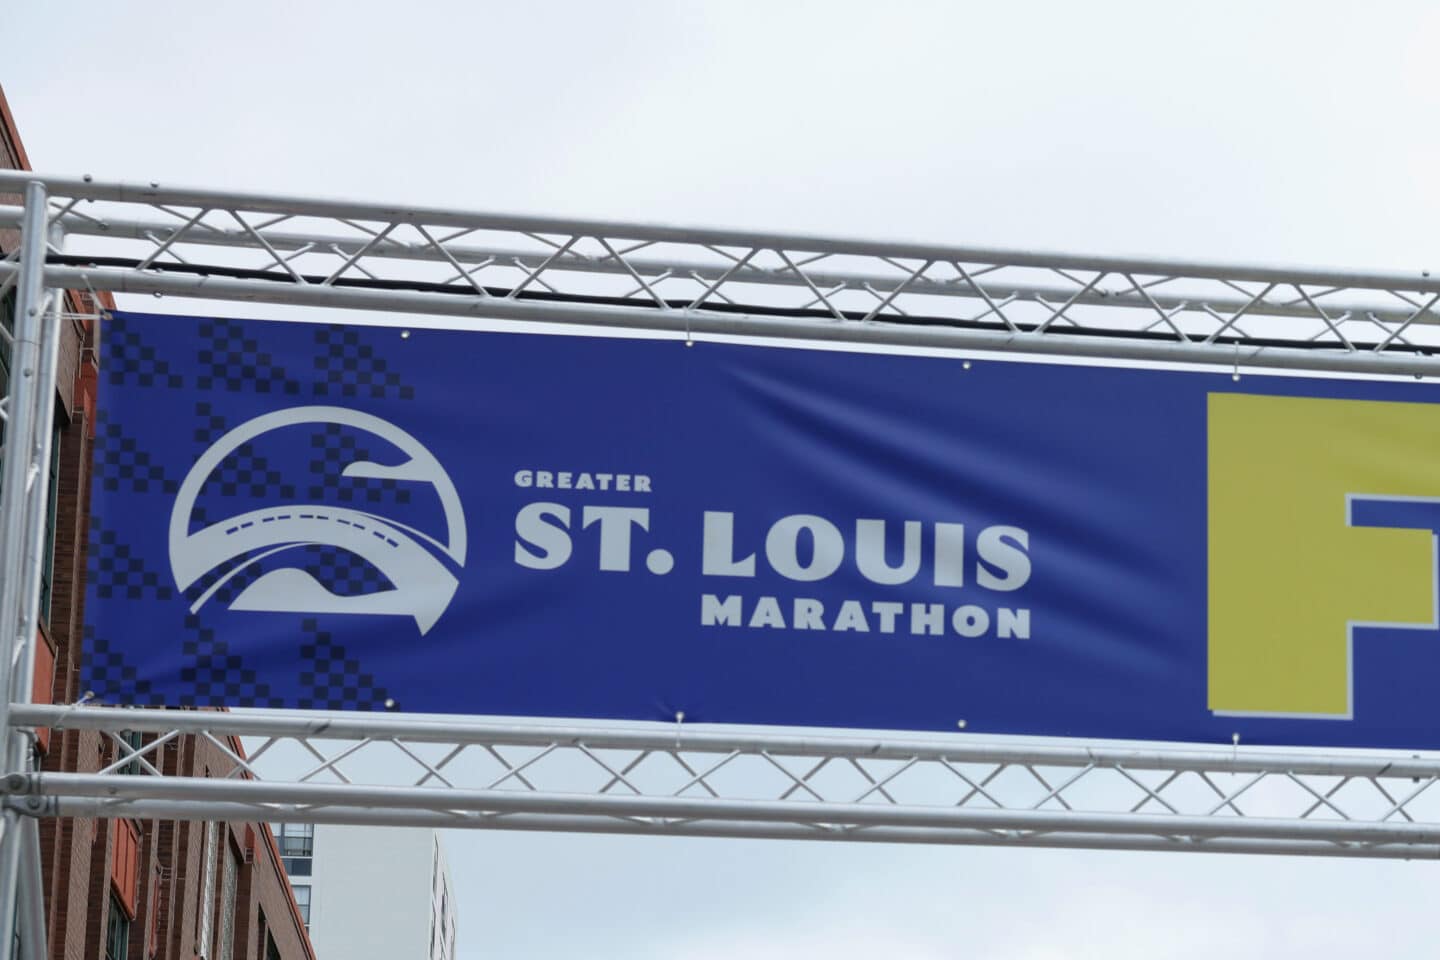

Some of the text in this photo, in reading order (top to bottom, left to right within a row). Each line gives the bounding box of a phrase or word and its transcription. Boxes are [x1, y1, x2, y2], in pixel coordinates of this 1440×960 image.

[513, 469, 652, 493] GREATER
[513, 501, 1032, 592] ST. LOUIS
[700, 594, 1031, 640] MARATHON
